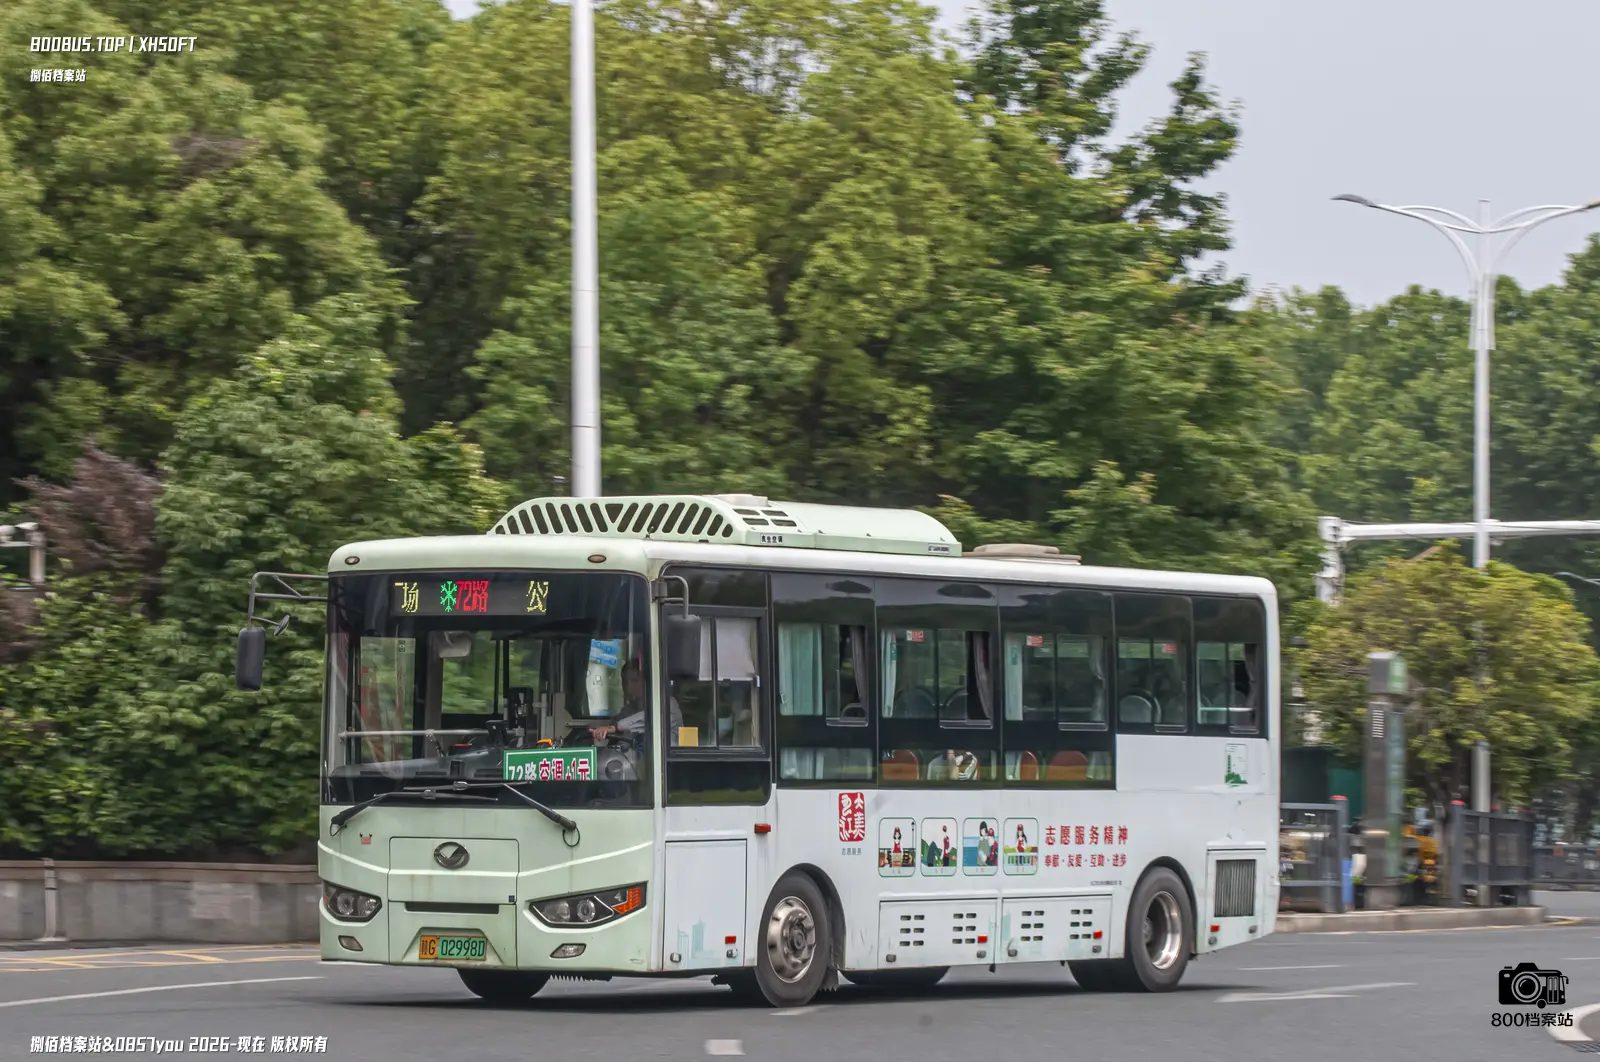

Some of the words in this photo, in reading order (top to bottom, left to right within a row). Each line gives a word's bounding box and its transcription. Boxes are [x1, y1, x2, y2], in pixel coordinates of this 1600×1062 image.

[456, 580, 489, 612] 72路
[526, 580, 549, 613] 公
[1044, 825, 1128, 846] 志愿服务精神
